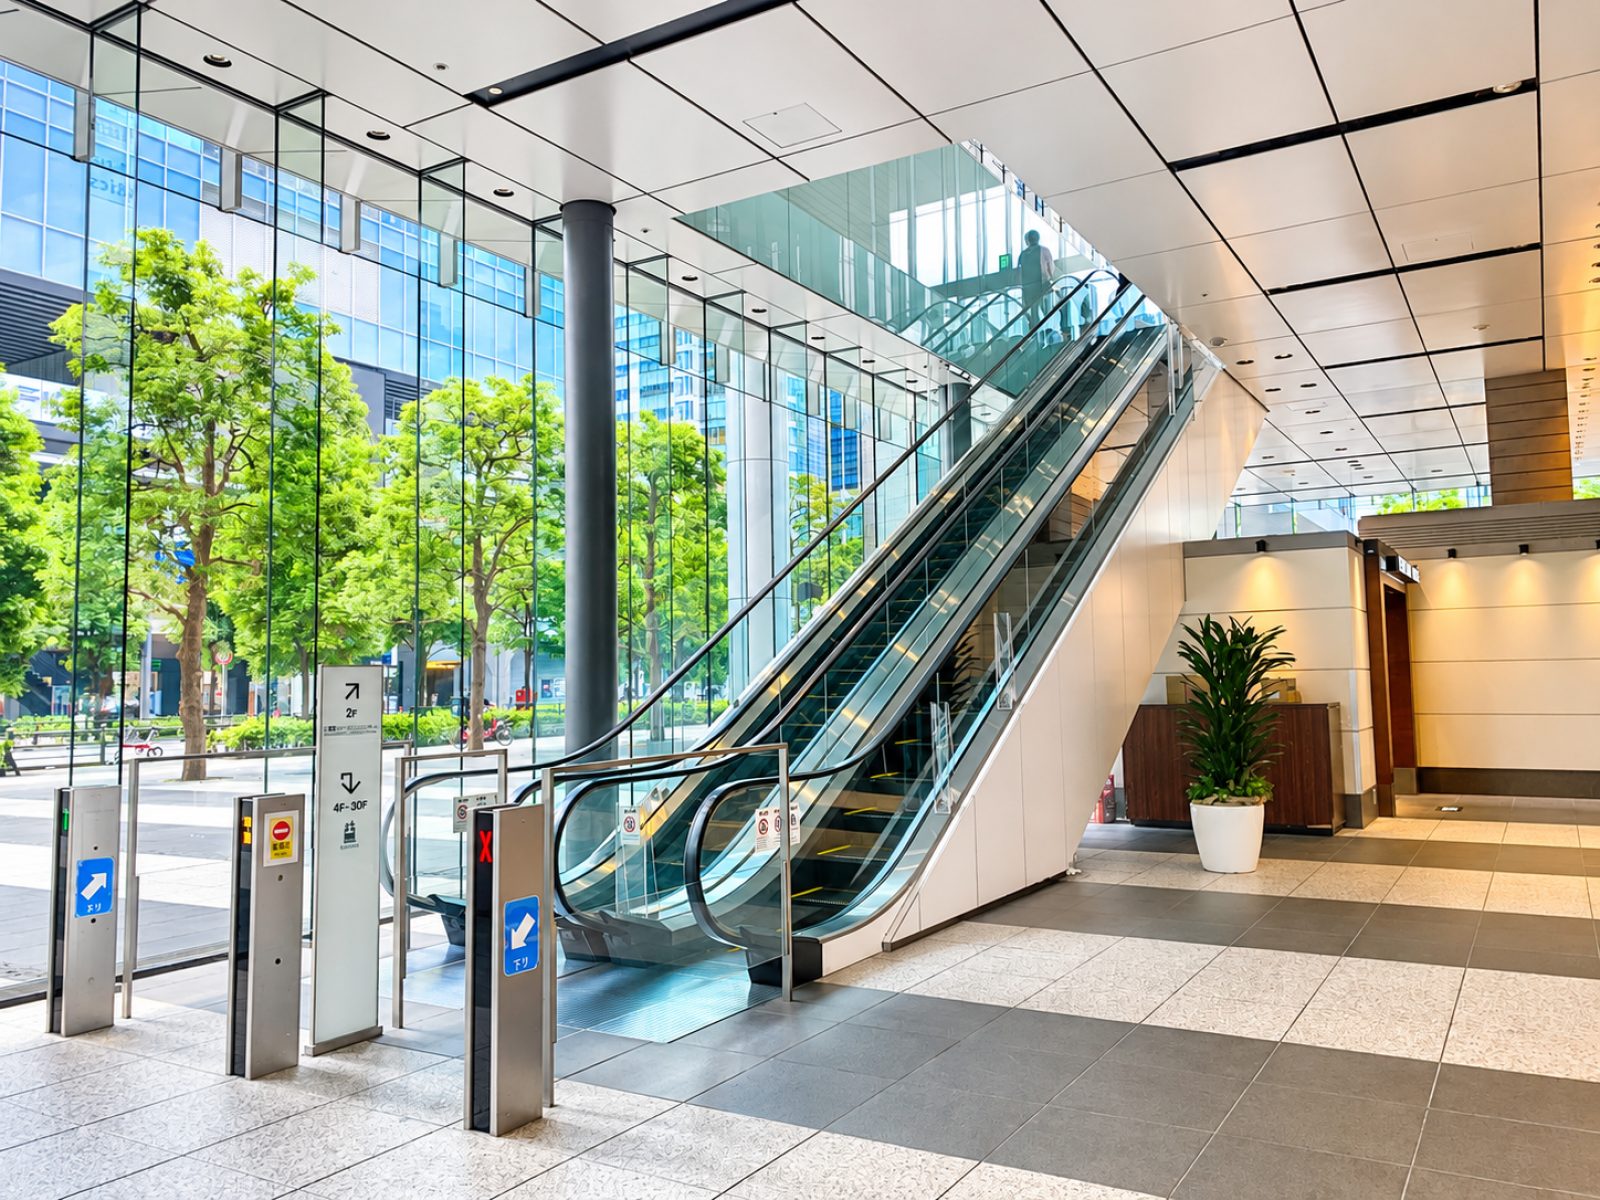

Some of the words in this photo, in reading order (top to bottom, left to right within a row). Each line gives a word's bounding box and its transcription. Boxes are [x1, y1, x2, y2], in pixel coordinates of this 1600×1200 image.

[345, 707, 357, 718] 2F
[333, 800, 368, 813] 4F-30F
[513, 956, 528, 971] 下り
